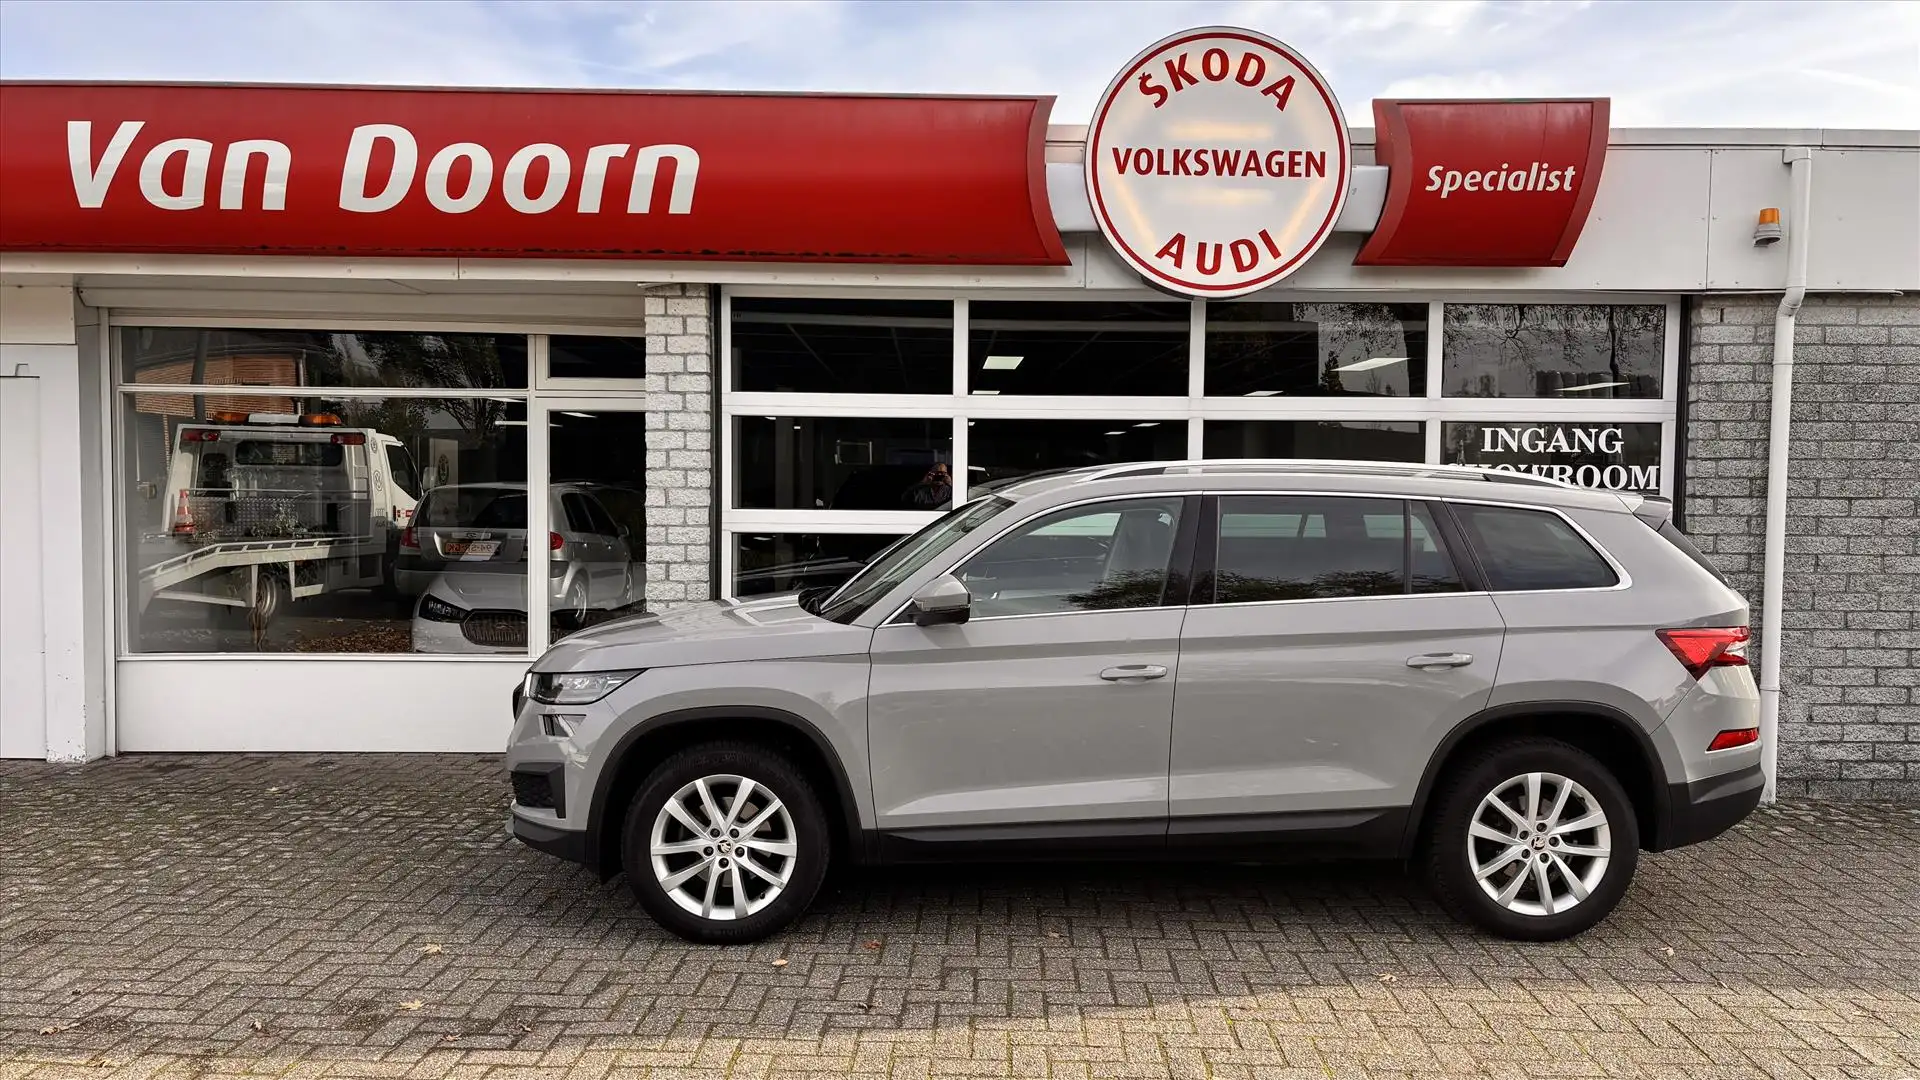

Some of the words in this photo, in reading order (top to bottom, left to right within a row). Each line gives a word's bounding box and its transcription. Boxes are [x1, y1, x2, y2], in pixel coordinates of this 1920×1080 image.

[1138, 47, 1297, 112] ŠKODA
[66, 120, 292, 210] Van
[338, 123, 701, 214] Doorn
[1112, 147, 1326, 178] VOLKSWAGEN
[1425, 162, 1576, 198] Specialist
[1155, 228, 1282, 275] AUDI
[1481, 427, 1624, 454] INGANG
[1447, 463, 1660, 490] ROOM
